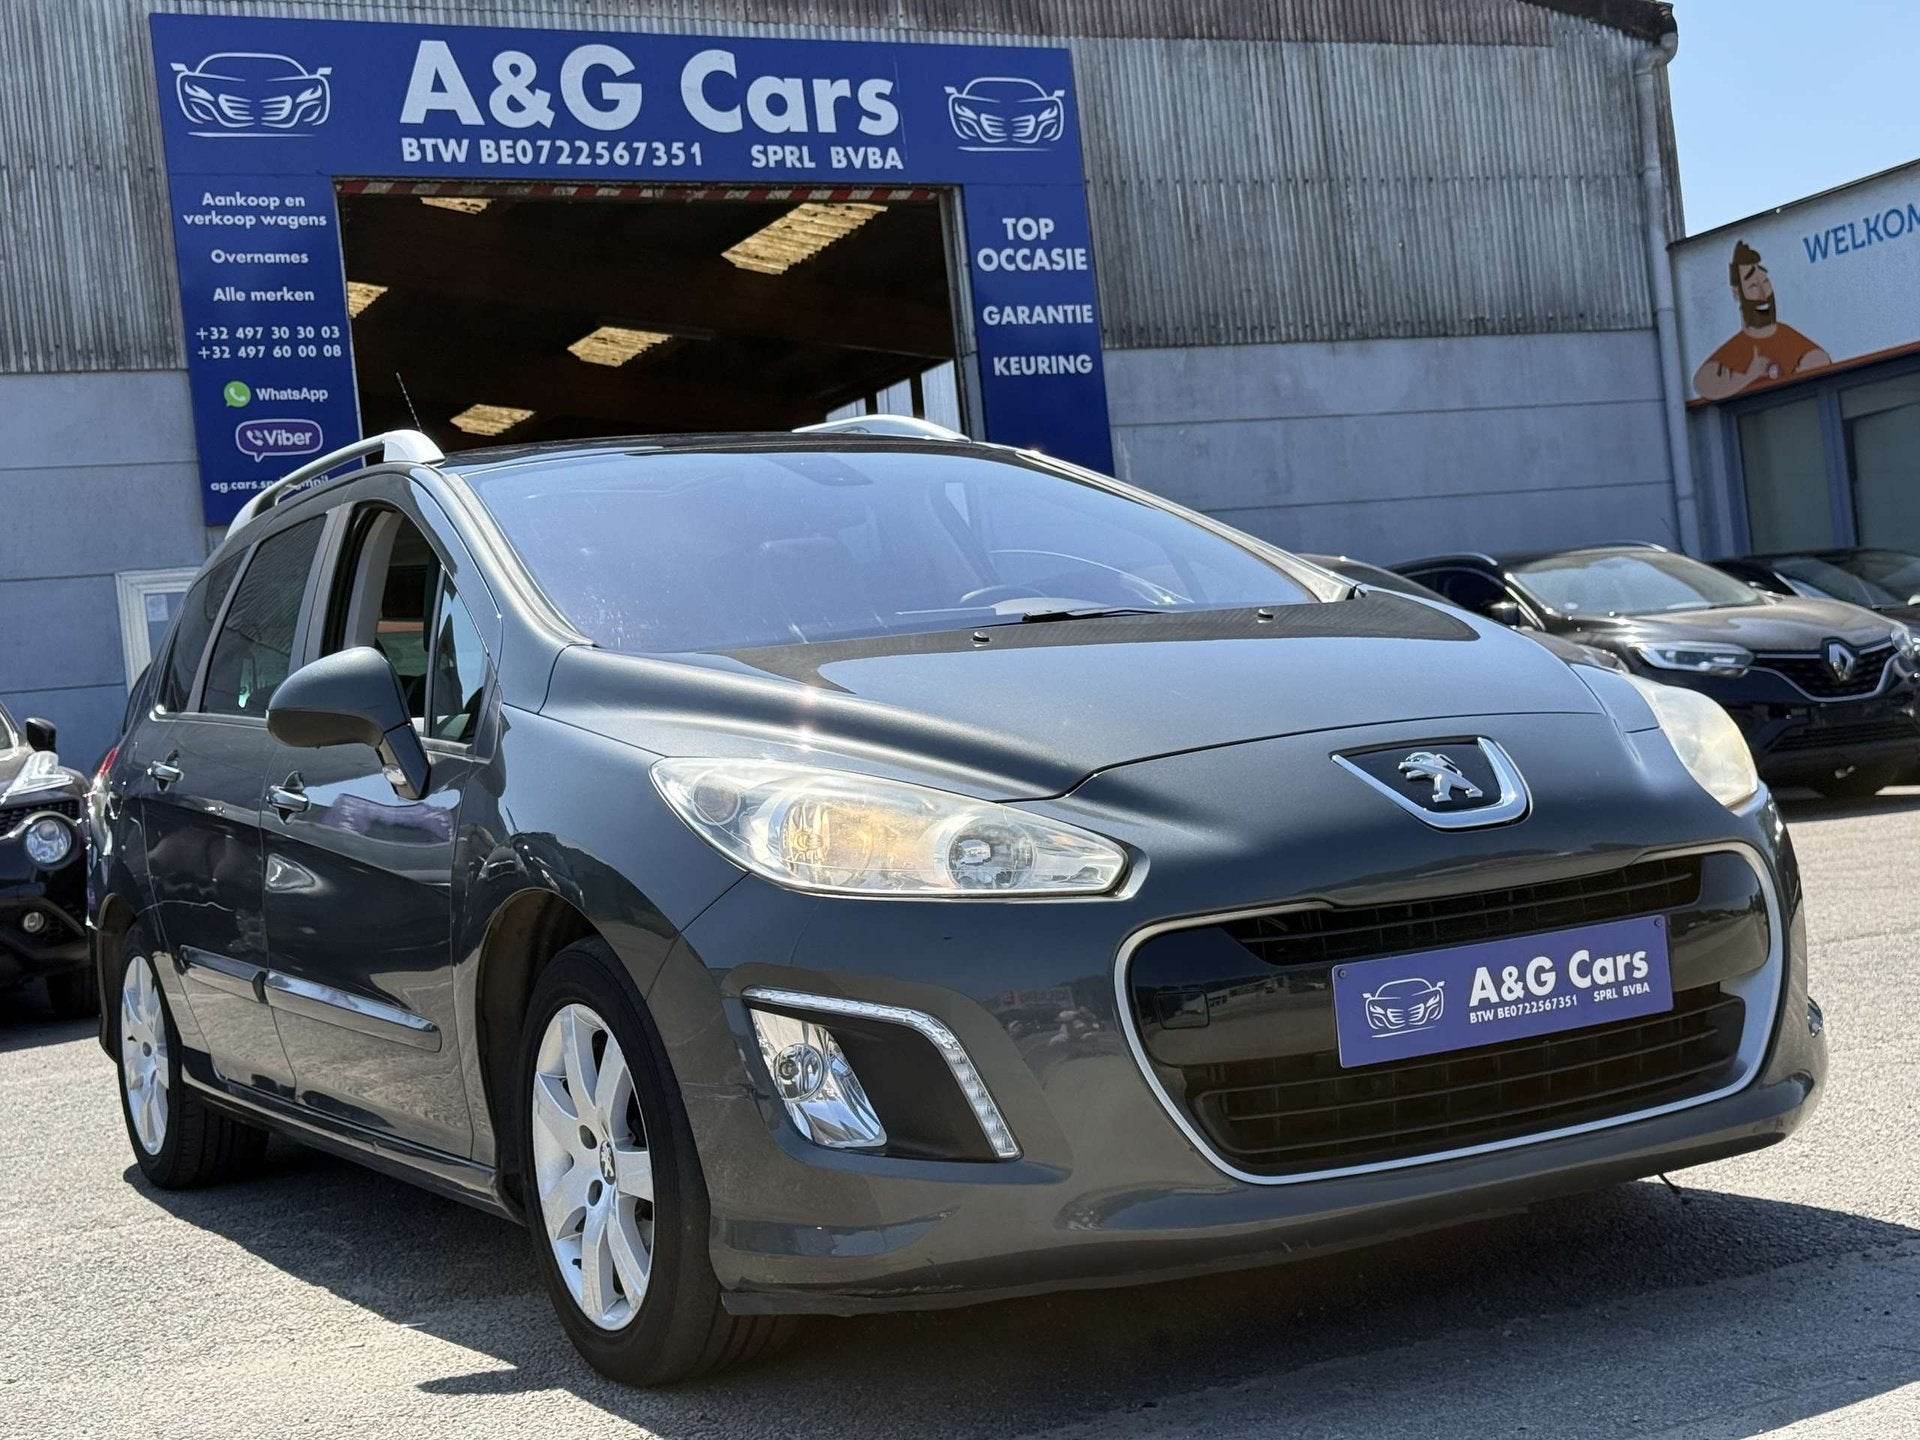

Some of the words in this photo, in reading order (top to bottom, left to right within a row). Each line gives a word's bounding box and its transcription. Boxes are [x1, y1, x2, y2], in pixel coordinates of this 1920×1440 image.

[399, 39, 643, 131] A&G
[679, 49, 900, 137] Cars
[401, 138, 469, 164] BTW
[480, 138, 703, 167] BE0722567351
[751, 145, 816, 169] SPRL
[831, 146, 904, 170] BVBA
[202, 192, 280, 209] Aankoop
[285, 195, 306, 207] en
[183, 211, 256, 228] verkoop
[260, 213, 327, 229] wagens
[1002, 217, 1055, 241] TOP
[210, 249, 309, 265] Overnames
[977, 248, 1088, 272] OCCASIE
[213, 287, 246, 302] Alle
[251, 287, 315, 302] merken
[982, 304, 1094, 326] GARANTIE
[195, 326, 229, 341] +32
[236, 326, 263, 340] 497
[271, 326, 289, 339] 30
[297, 326, 315, 339] 30
[321, 326, 340, 338] 03
[198, 346, 231, 360] +32
[238, 346, 265, 359] 497
[273, 346, 292, 358] 60
[298, 345, 317, 358] 00
[323, 345, 342, 358] 08
[993, 354, 1093, 376] KEURING
[255, 387, 329, 402] WhatsApp
[263, 429, 313, 447] Viber
[1468, 956, 1557, 1007] A&G
[1568, 949, 1649, 989] Cars
[1593, 987, 1618, 1003] SPRL
[1622, 982, 1650, 998] BVBA
[1469, 1008, 1495, 1024] BTW
[1497, 995, 1578, 1020] BE0722567351
